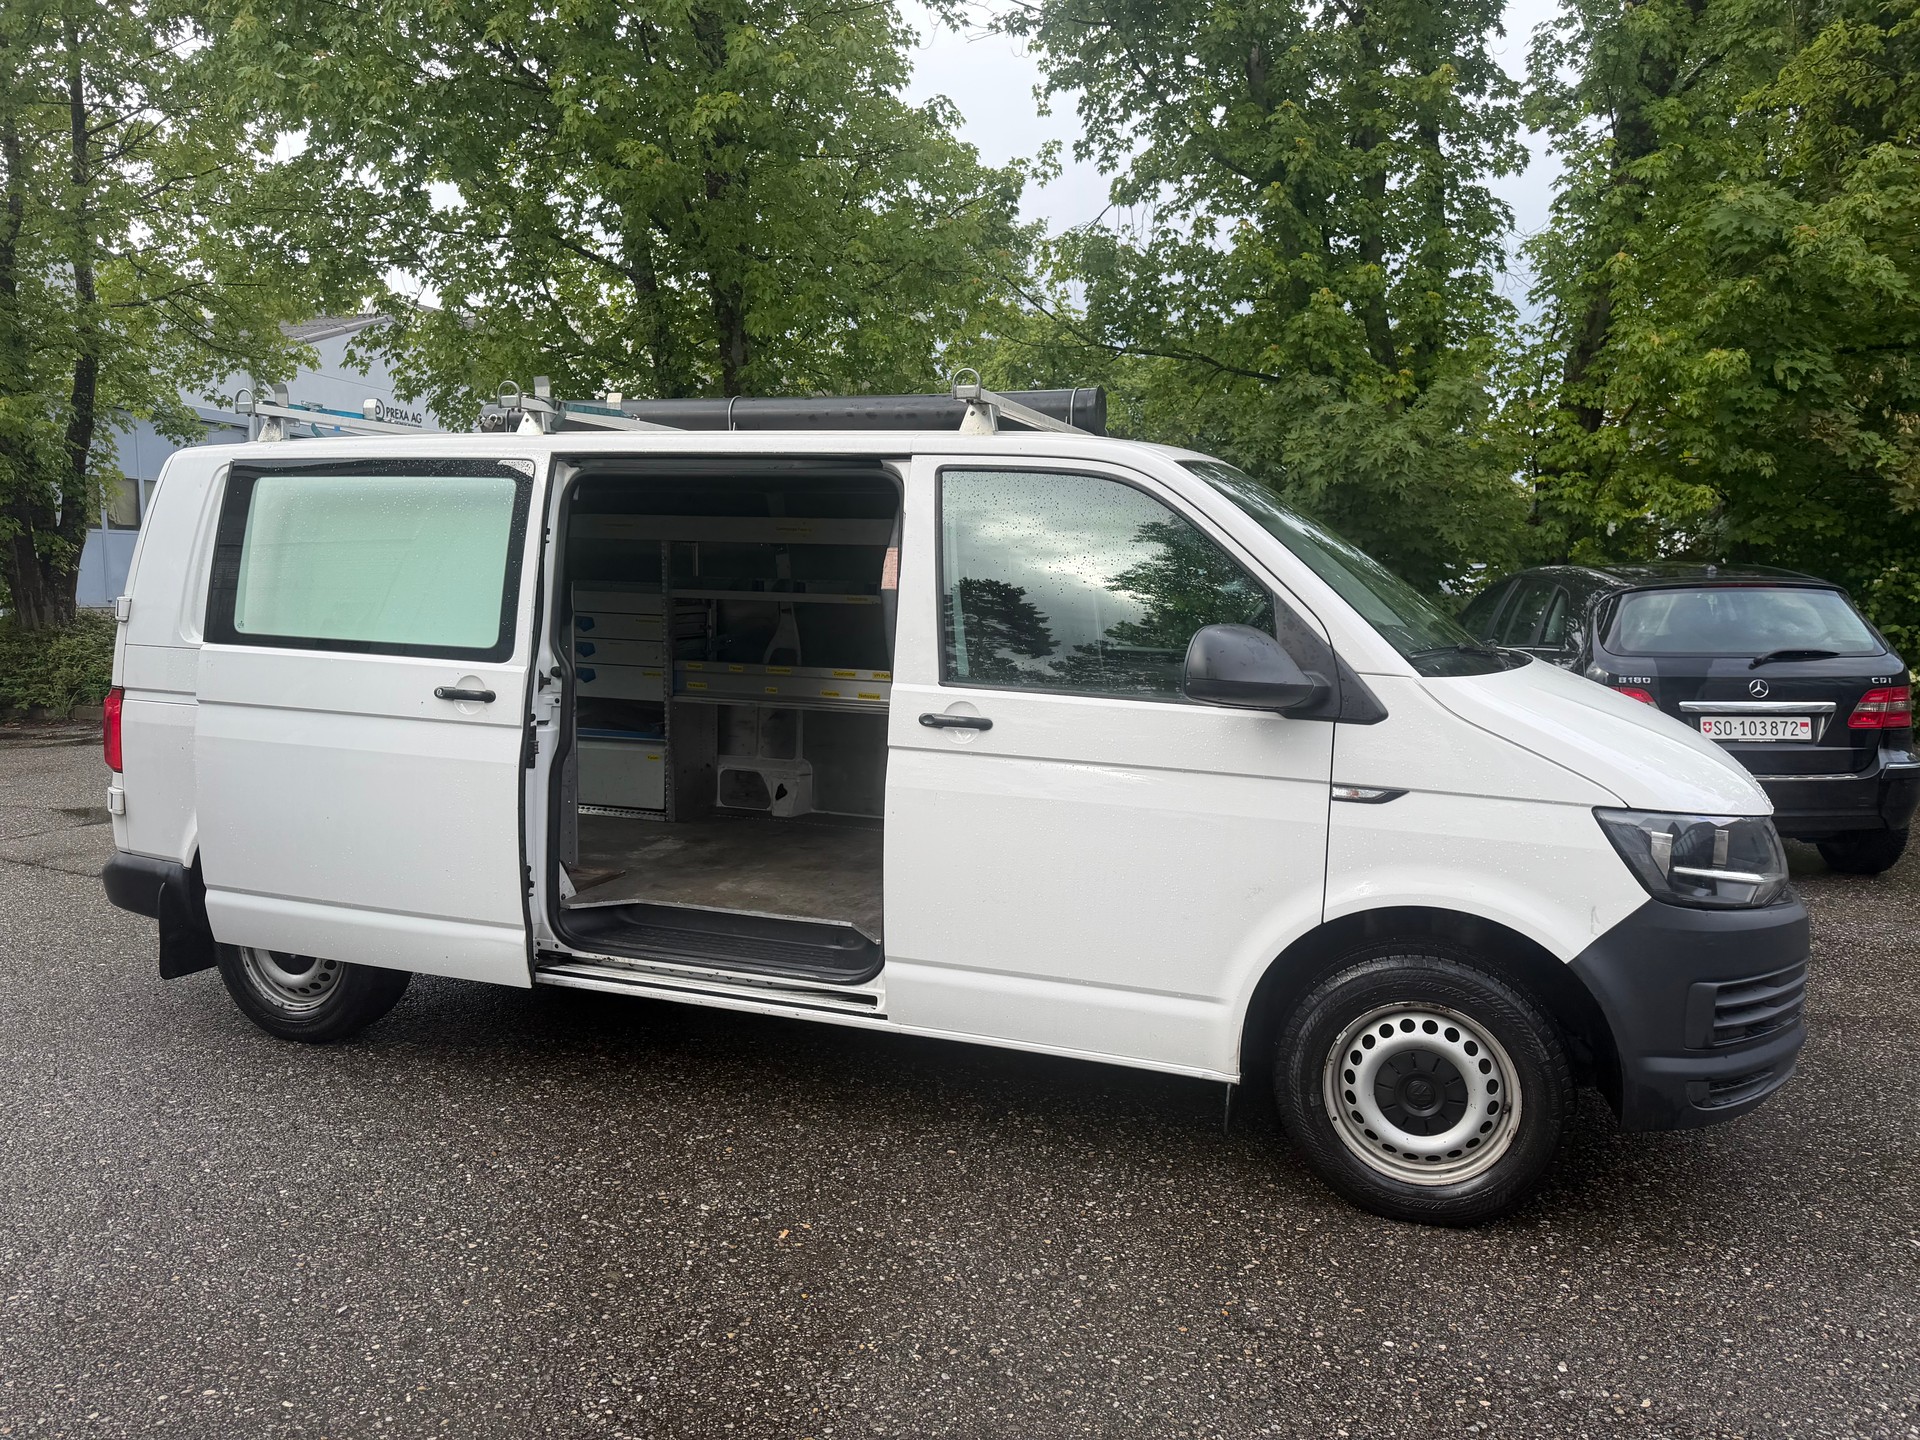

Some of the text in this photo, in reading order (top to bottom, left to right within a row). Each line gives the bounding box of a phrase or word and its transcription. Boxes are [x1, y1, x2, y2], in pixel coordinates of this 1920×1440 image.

[386, 406, 409, 421] PREXA
[411, 412, 422, 424] AG
[1871, 676, 1892, 684] CDI
